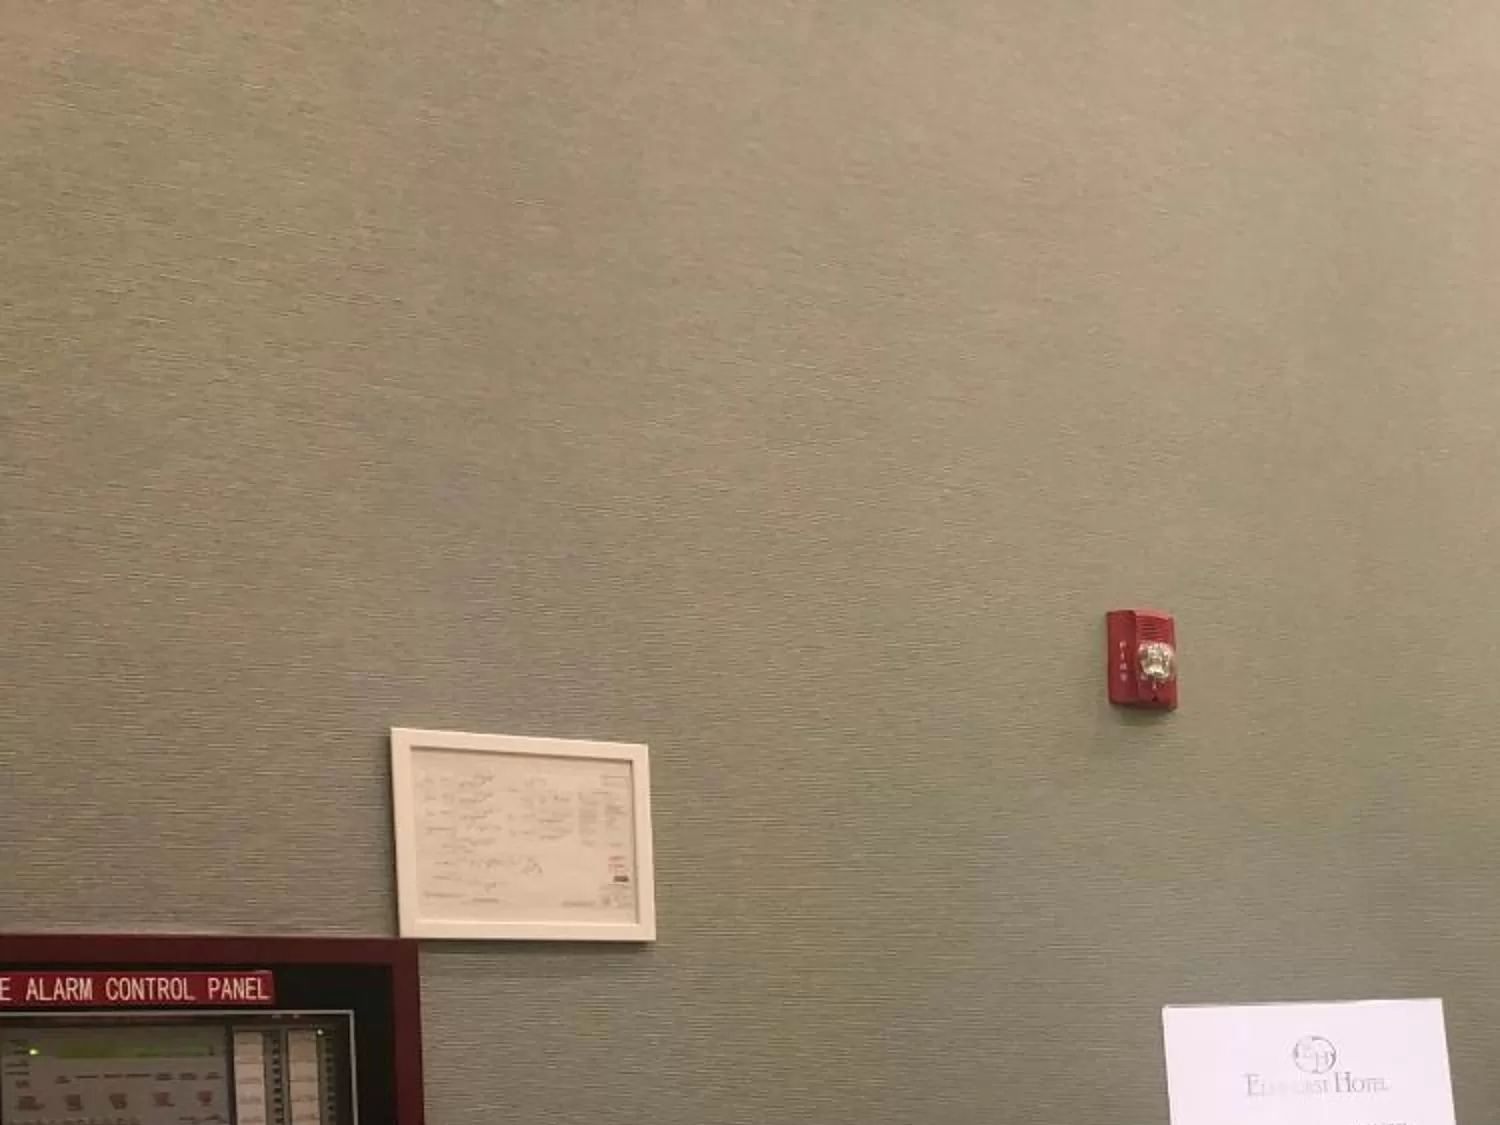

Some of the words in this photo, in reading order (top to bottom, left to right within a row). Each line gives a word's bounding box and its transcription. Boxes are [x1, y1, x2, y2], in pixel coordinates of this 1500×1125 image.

[26, 977, 94, 1001] ALARM
[105, 977, 196, 1001] CONTROL
[207, 977, 270, 1001] PANEL
